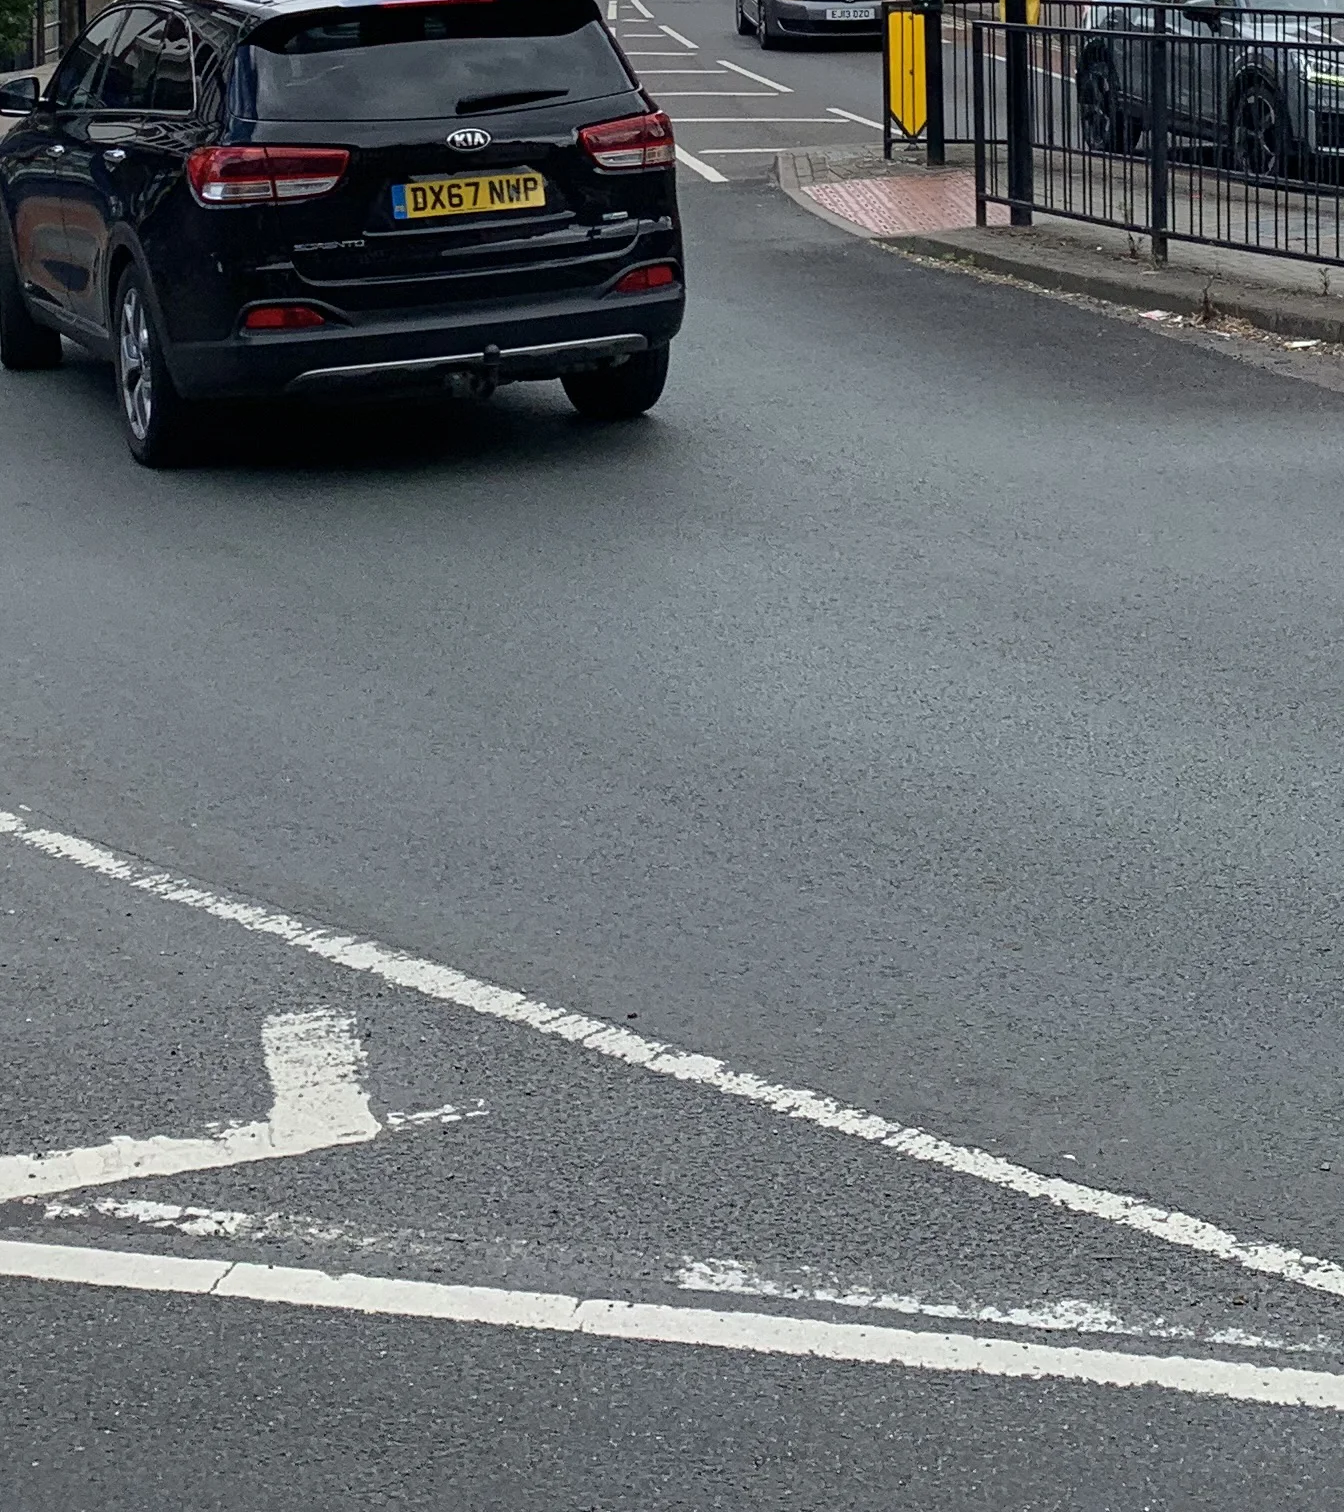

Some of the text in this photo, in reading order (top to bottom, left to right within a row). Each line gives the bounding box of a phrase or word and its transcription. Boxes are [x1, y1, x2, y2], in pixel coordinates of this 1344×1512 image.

[831, 10, 851, 19] EJ13
[454, 132, 485, 147] KIA
[410, 176, 539, 213] DX67 NWP
